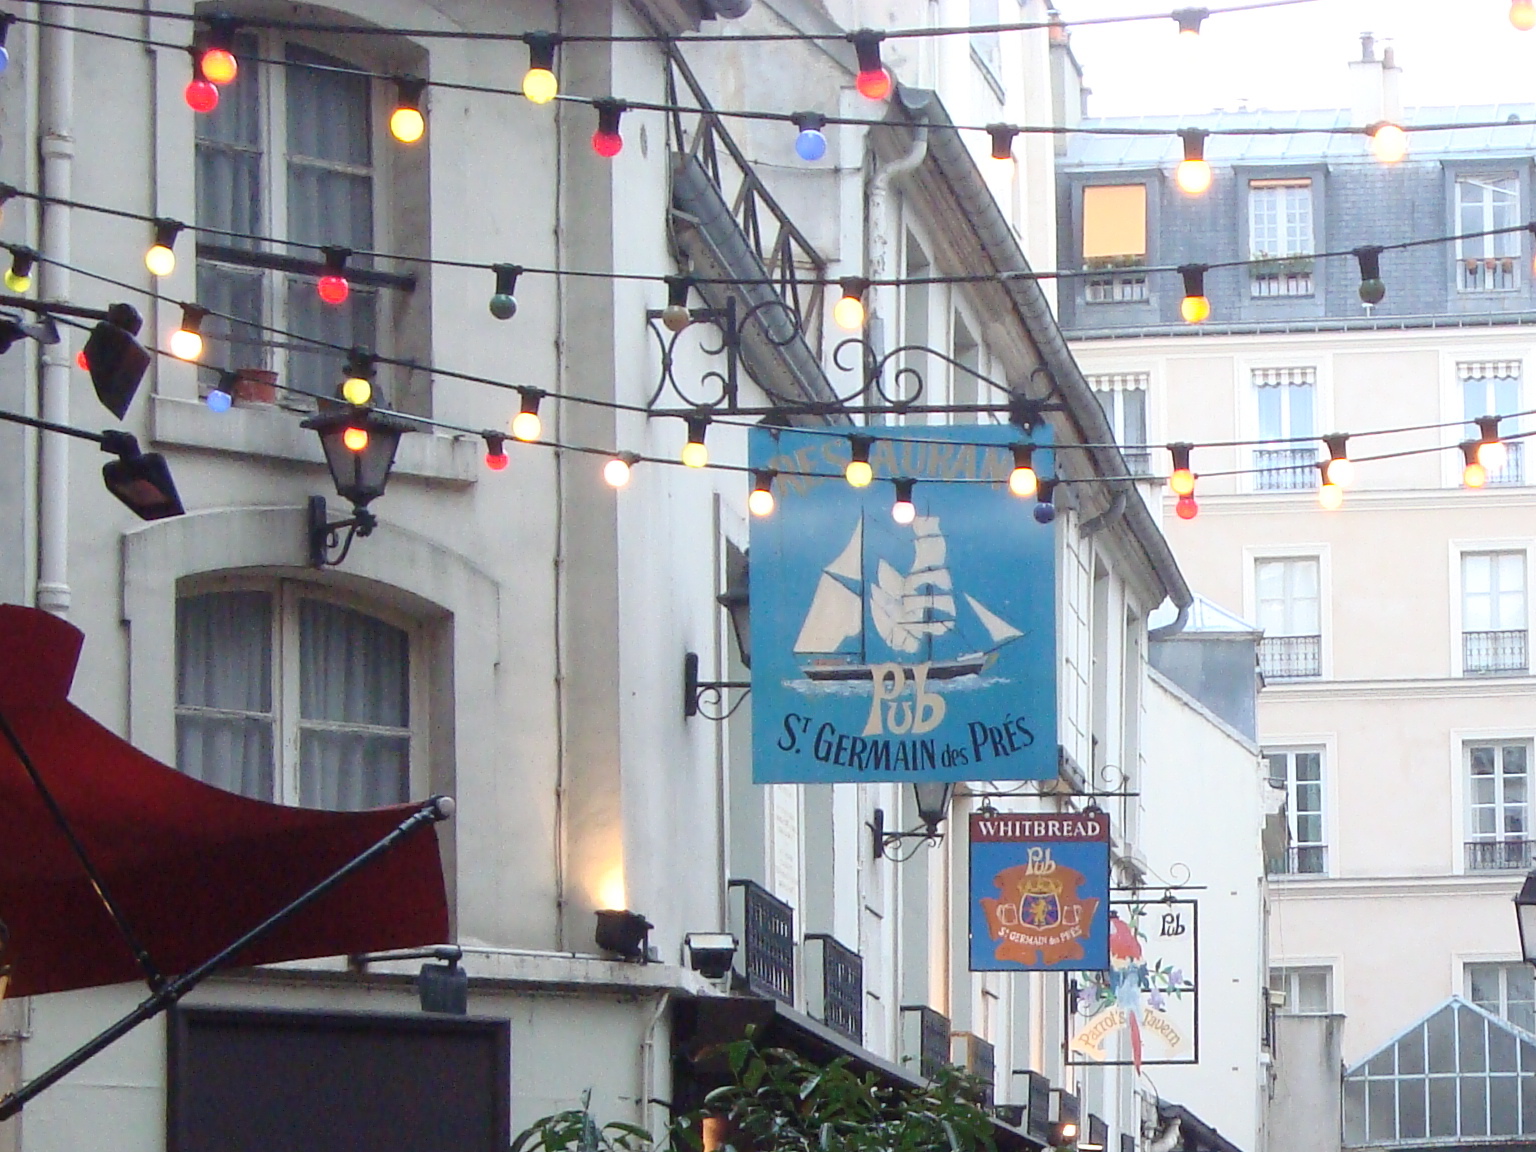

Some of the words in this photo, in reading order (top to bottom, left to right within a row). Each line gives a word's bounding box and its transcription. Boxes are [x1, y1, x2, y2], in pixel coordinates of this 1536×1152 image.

[862, 662, 946, 737] Pub
[813, 722, 936, 771] GERMAIN
[941, 744, 969, 768] des
[967, 713, 1035, 762] PRÉS
[978, 821, 1100, 837] WHITBREAD
[1025, 847, 1057, 875] Pub
[1009, 931, 1048, 945] GERMAIN
[1159, 912, 1186, 937] Pub
[1078, 1009, 1126, 1048] Parrot's
[1142, 1008, 1180, 1048] Tavern
